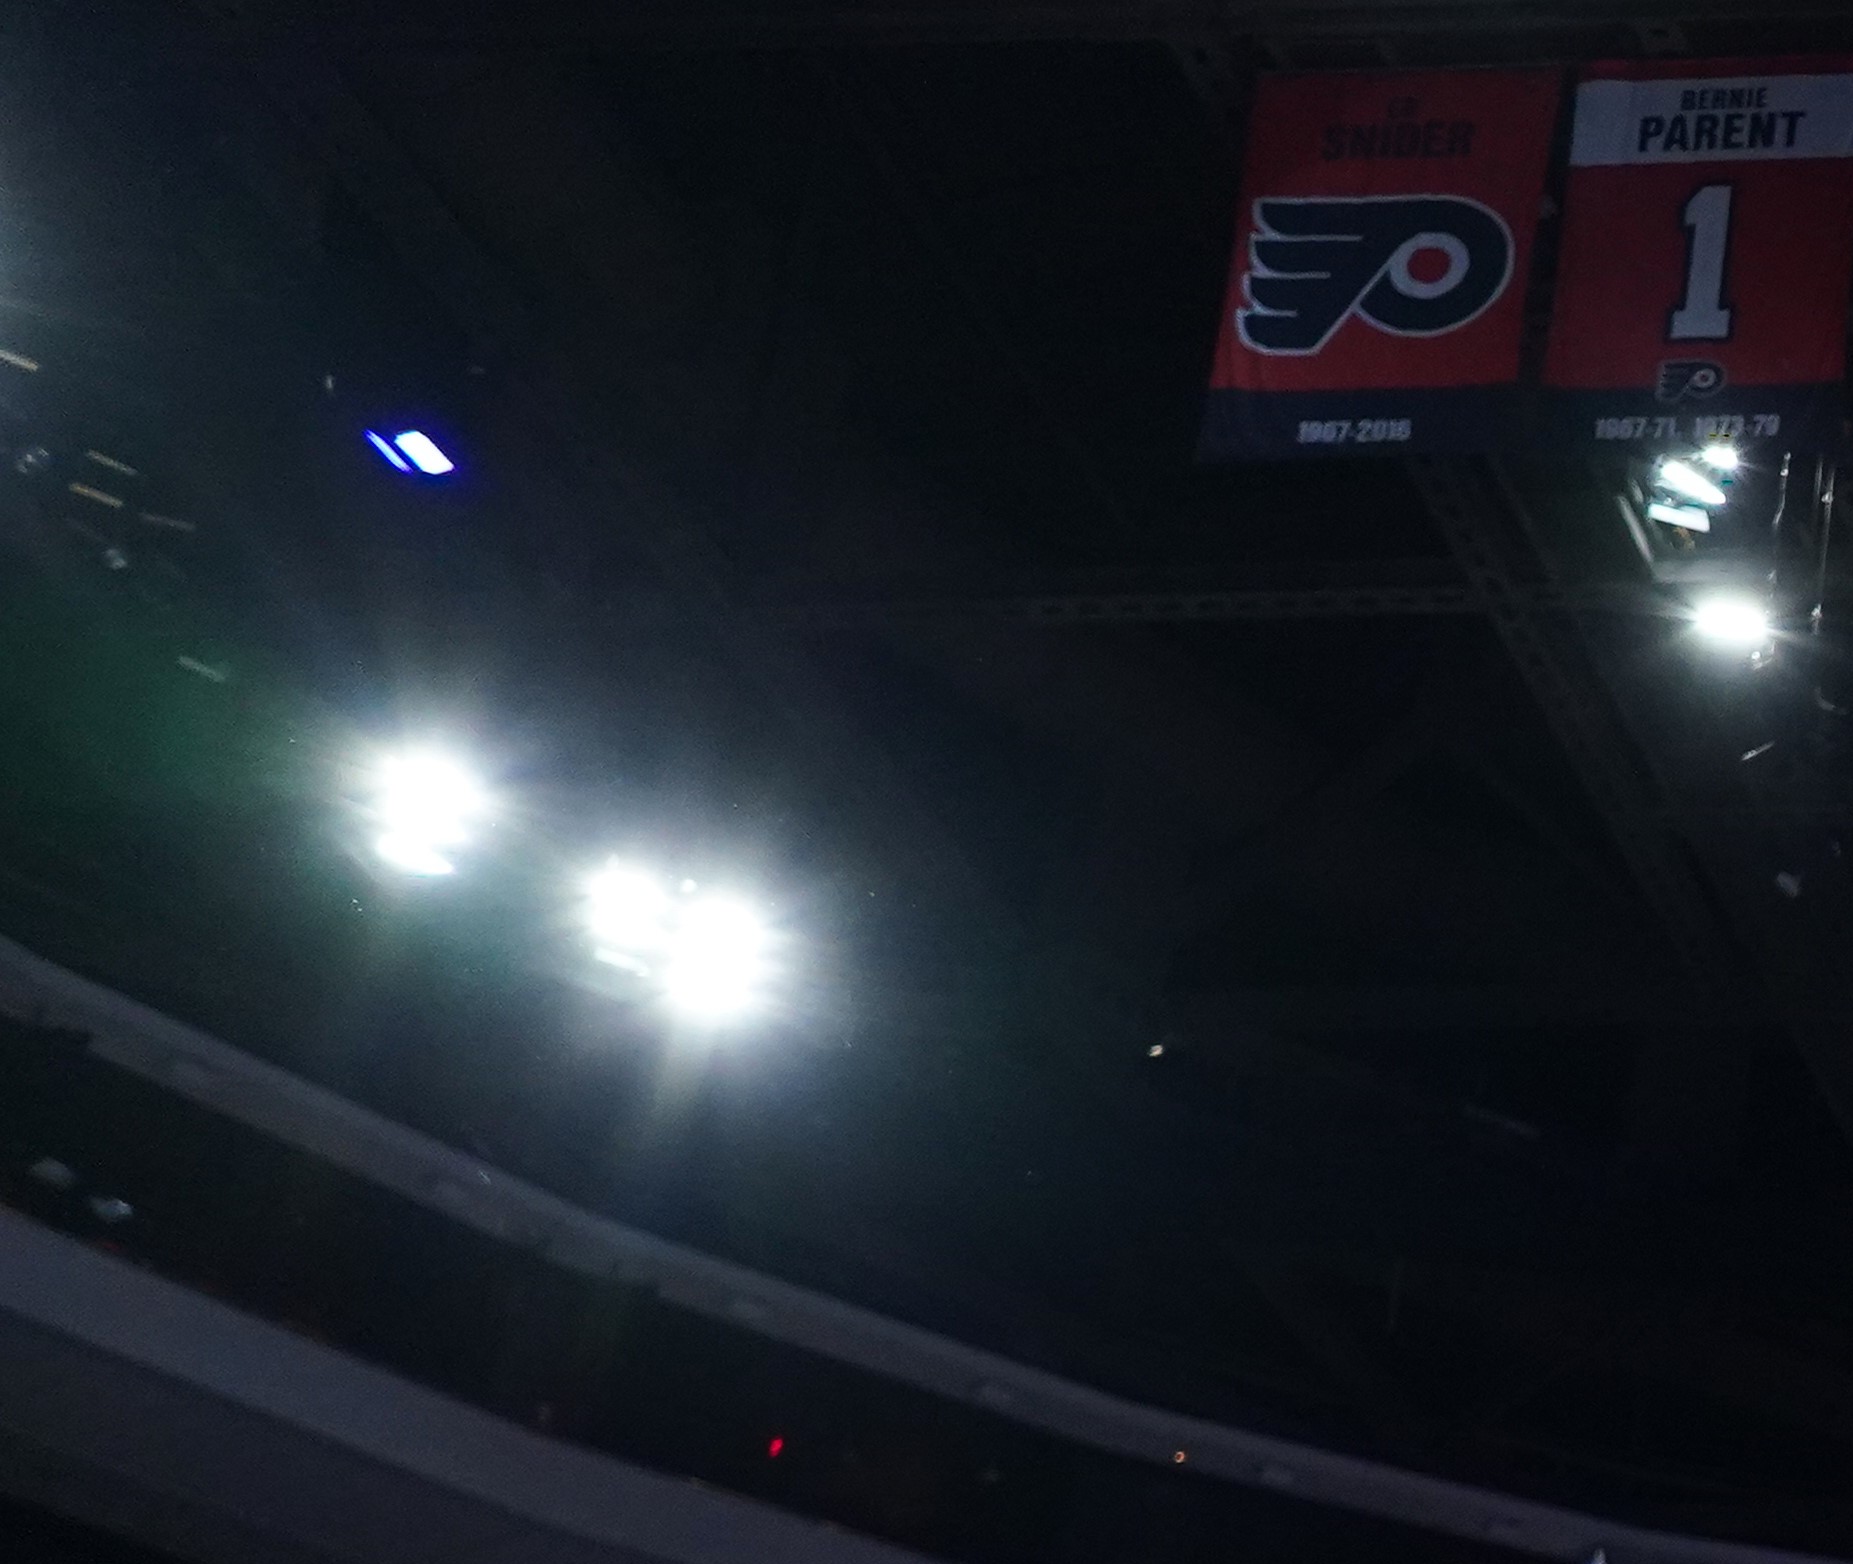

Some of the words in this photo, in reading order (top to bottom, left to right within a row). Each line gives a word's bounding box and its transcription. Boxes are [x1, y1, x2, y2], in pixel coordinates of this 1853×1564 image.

[1681, 88, 1767, 111] BERNIE
[1638, 112, 1805, 152] PARENT
[1665, 183, 1734, 343] 1
